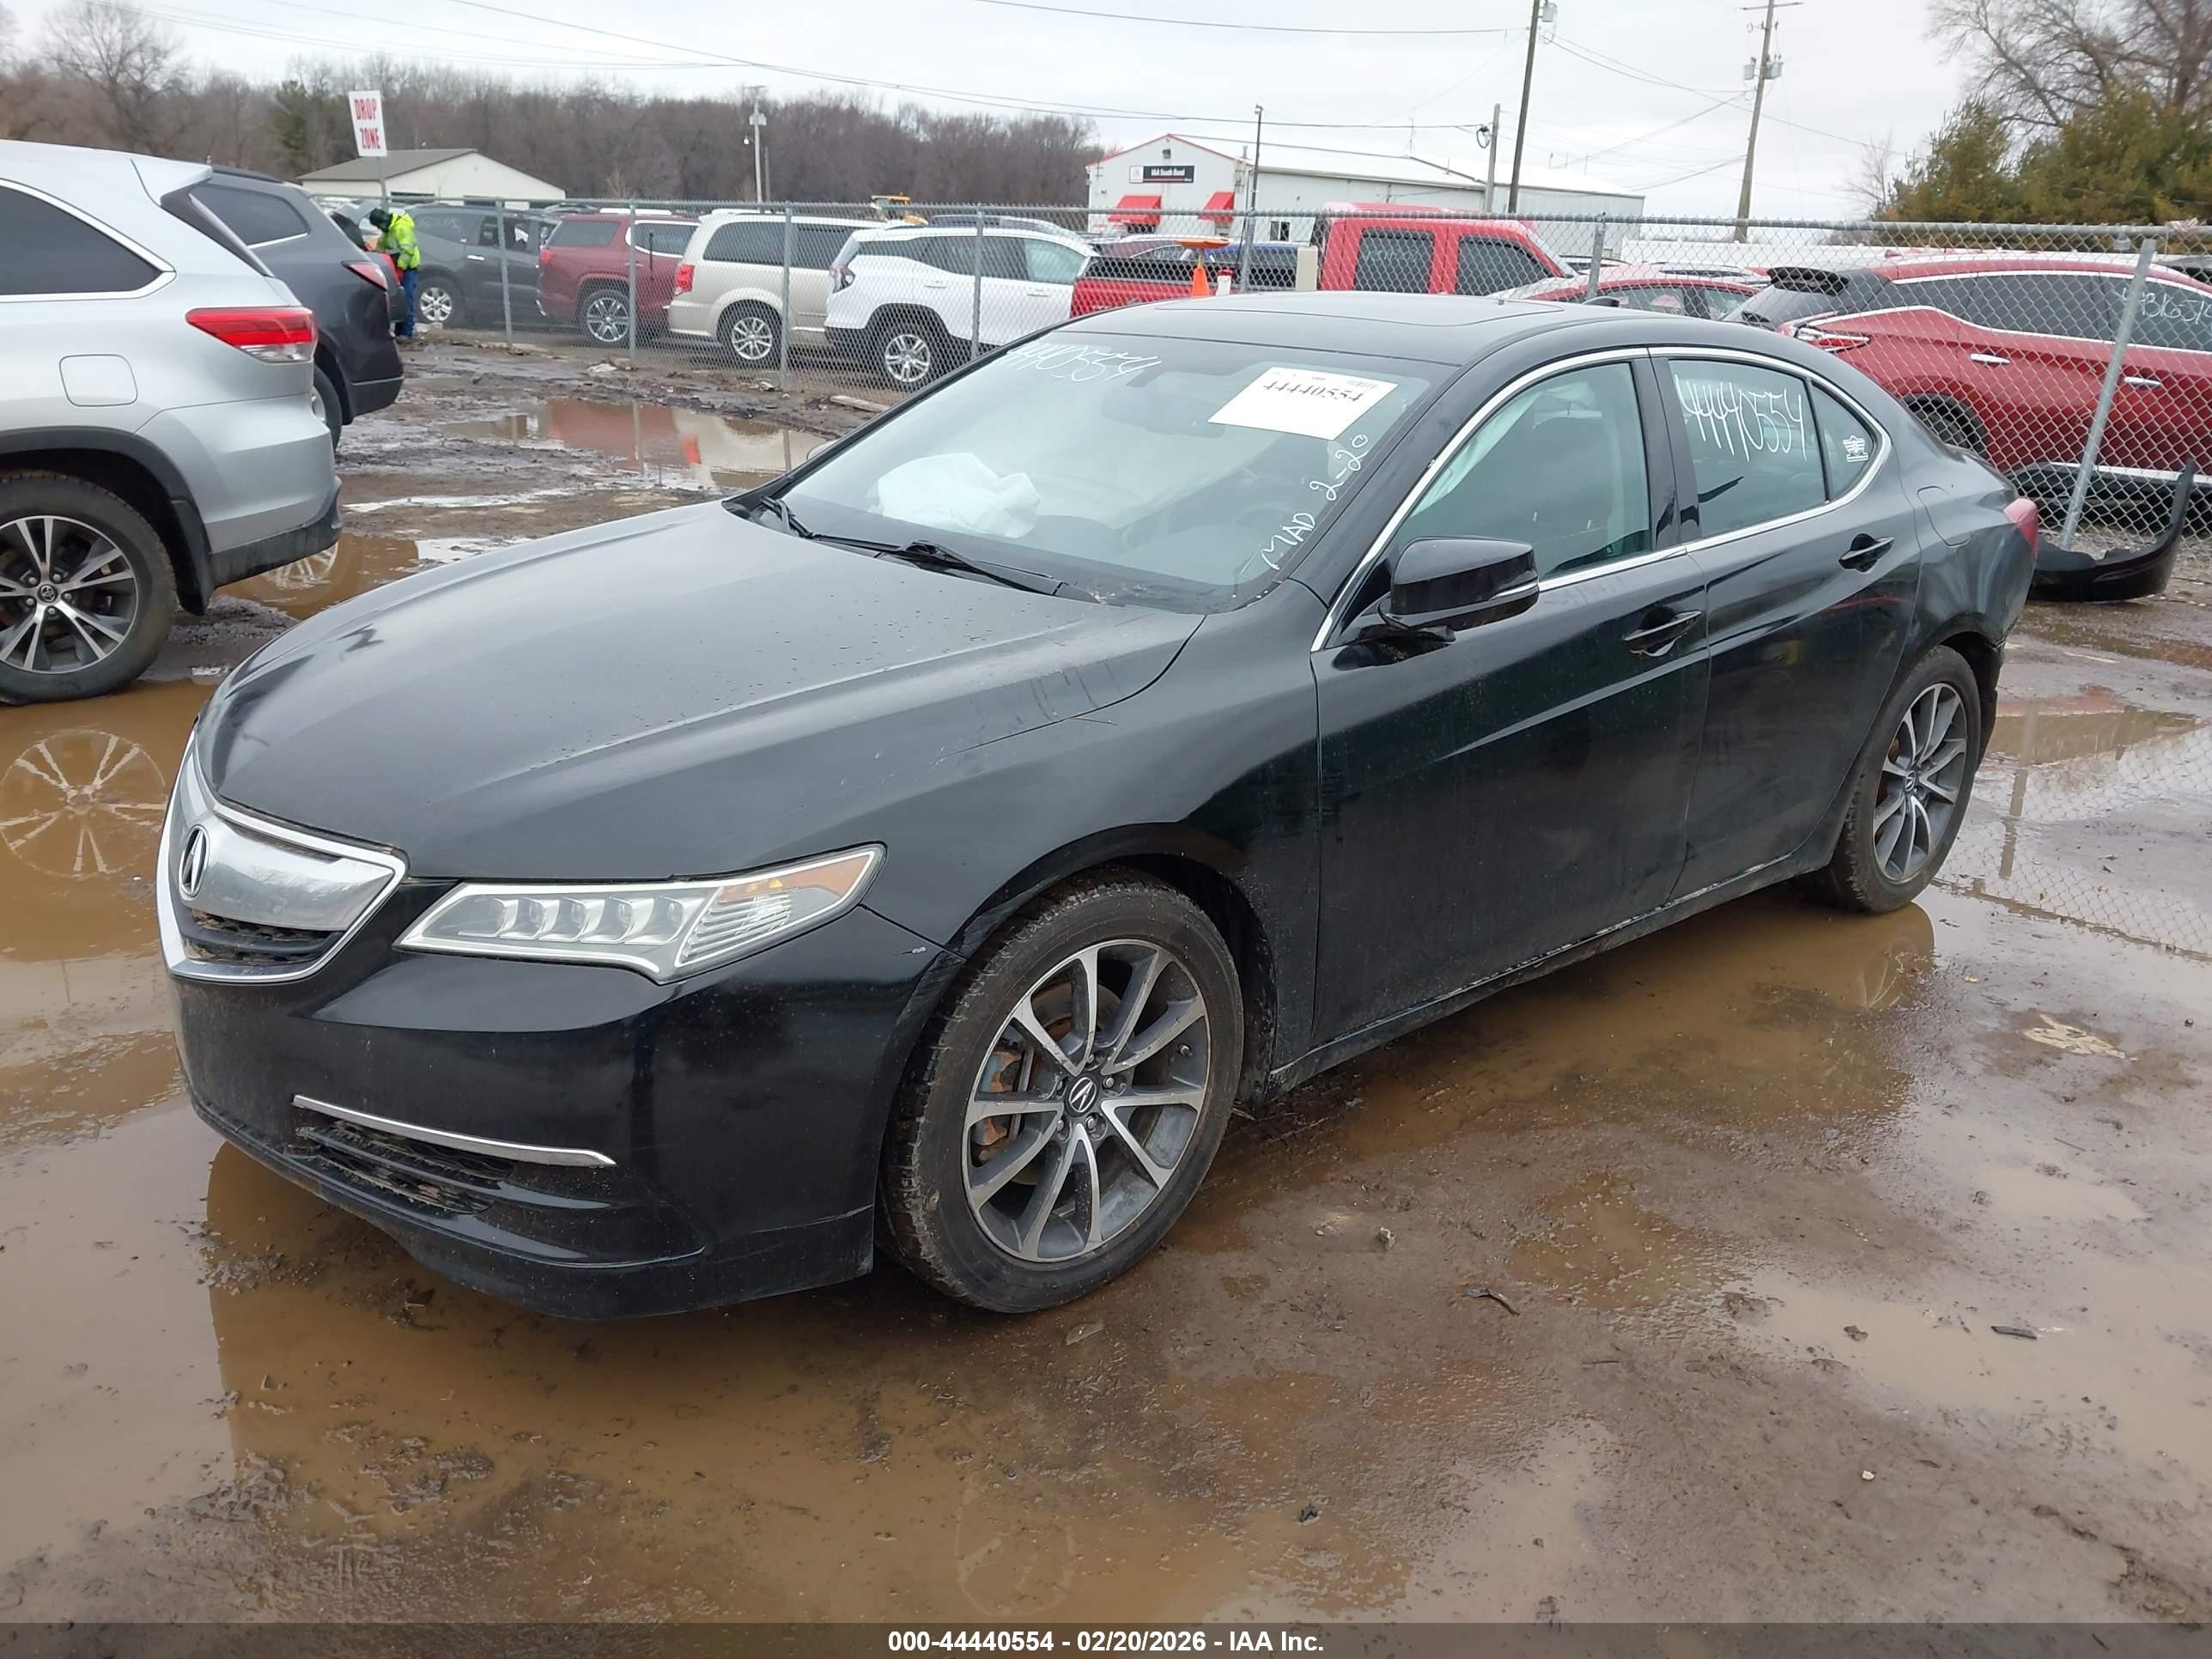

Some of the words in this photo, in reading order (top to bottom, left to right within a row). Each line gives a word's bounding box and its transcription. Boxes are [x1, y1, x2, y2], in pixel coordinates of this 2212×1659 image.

[355, 98, 377, 120] DROP
[360, 127, 380, 149] ZONE
[1264, 380, 1364, 402] 44440554
[1674, 374, 1807, 464] 44440554
[1310, 434, 1369, 501] 2-20
